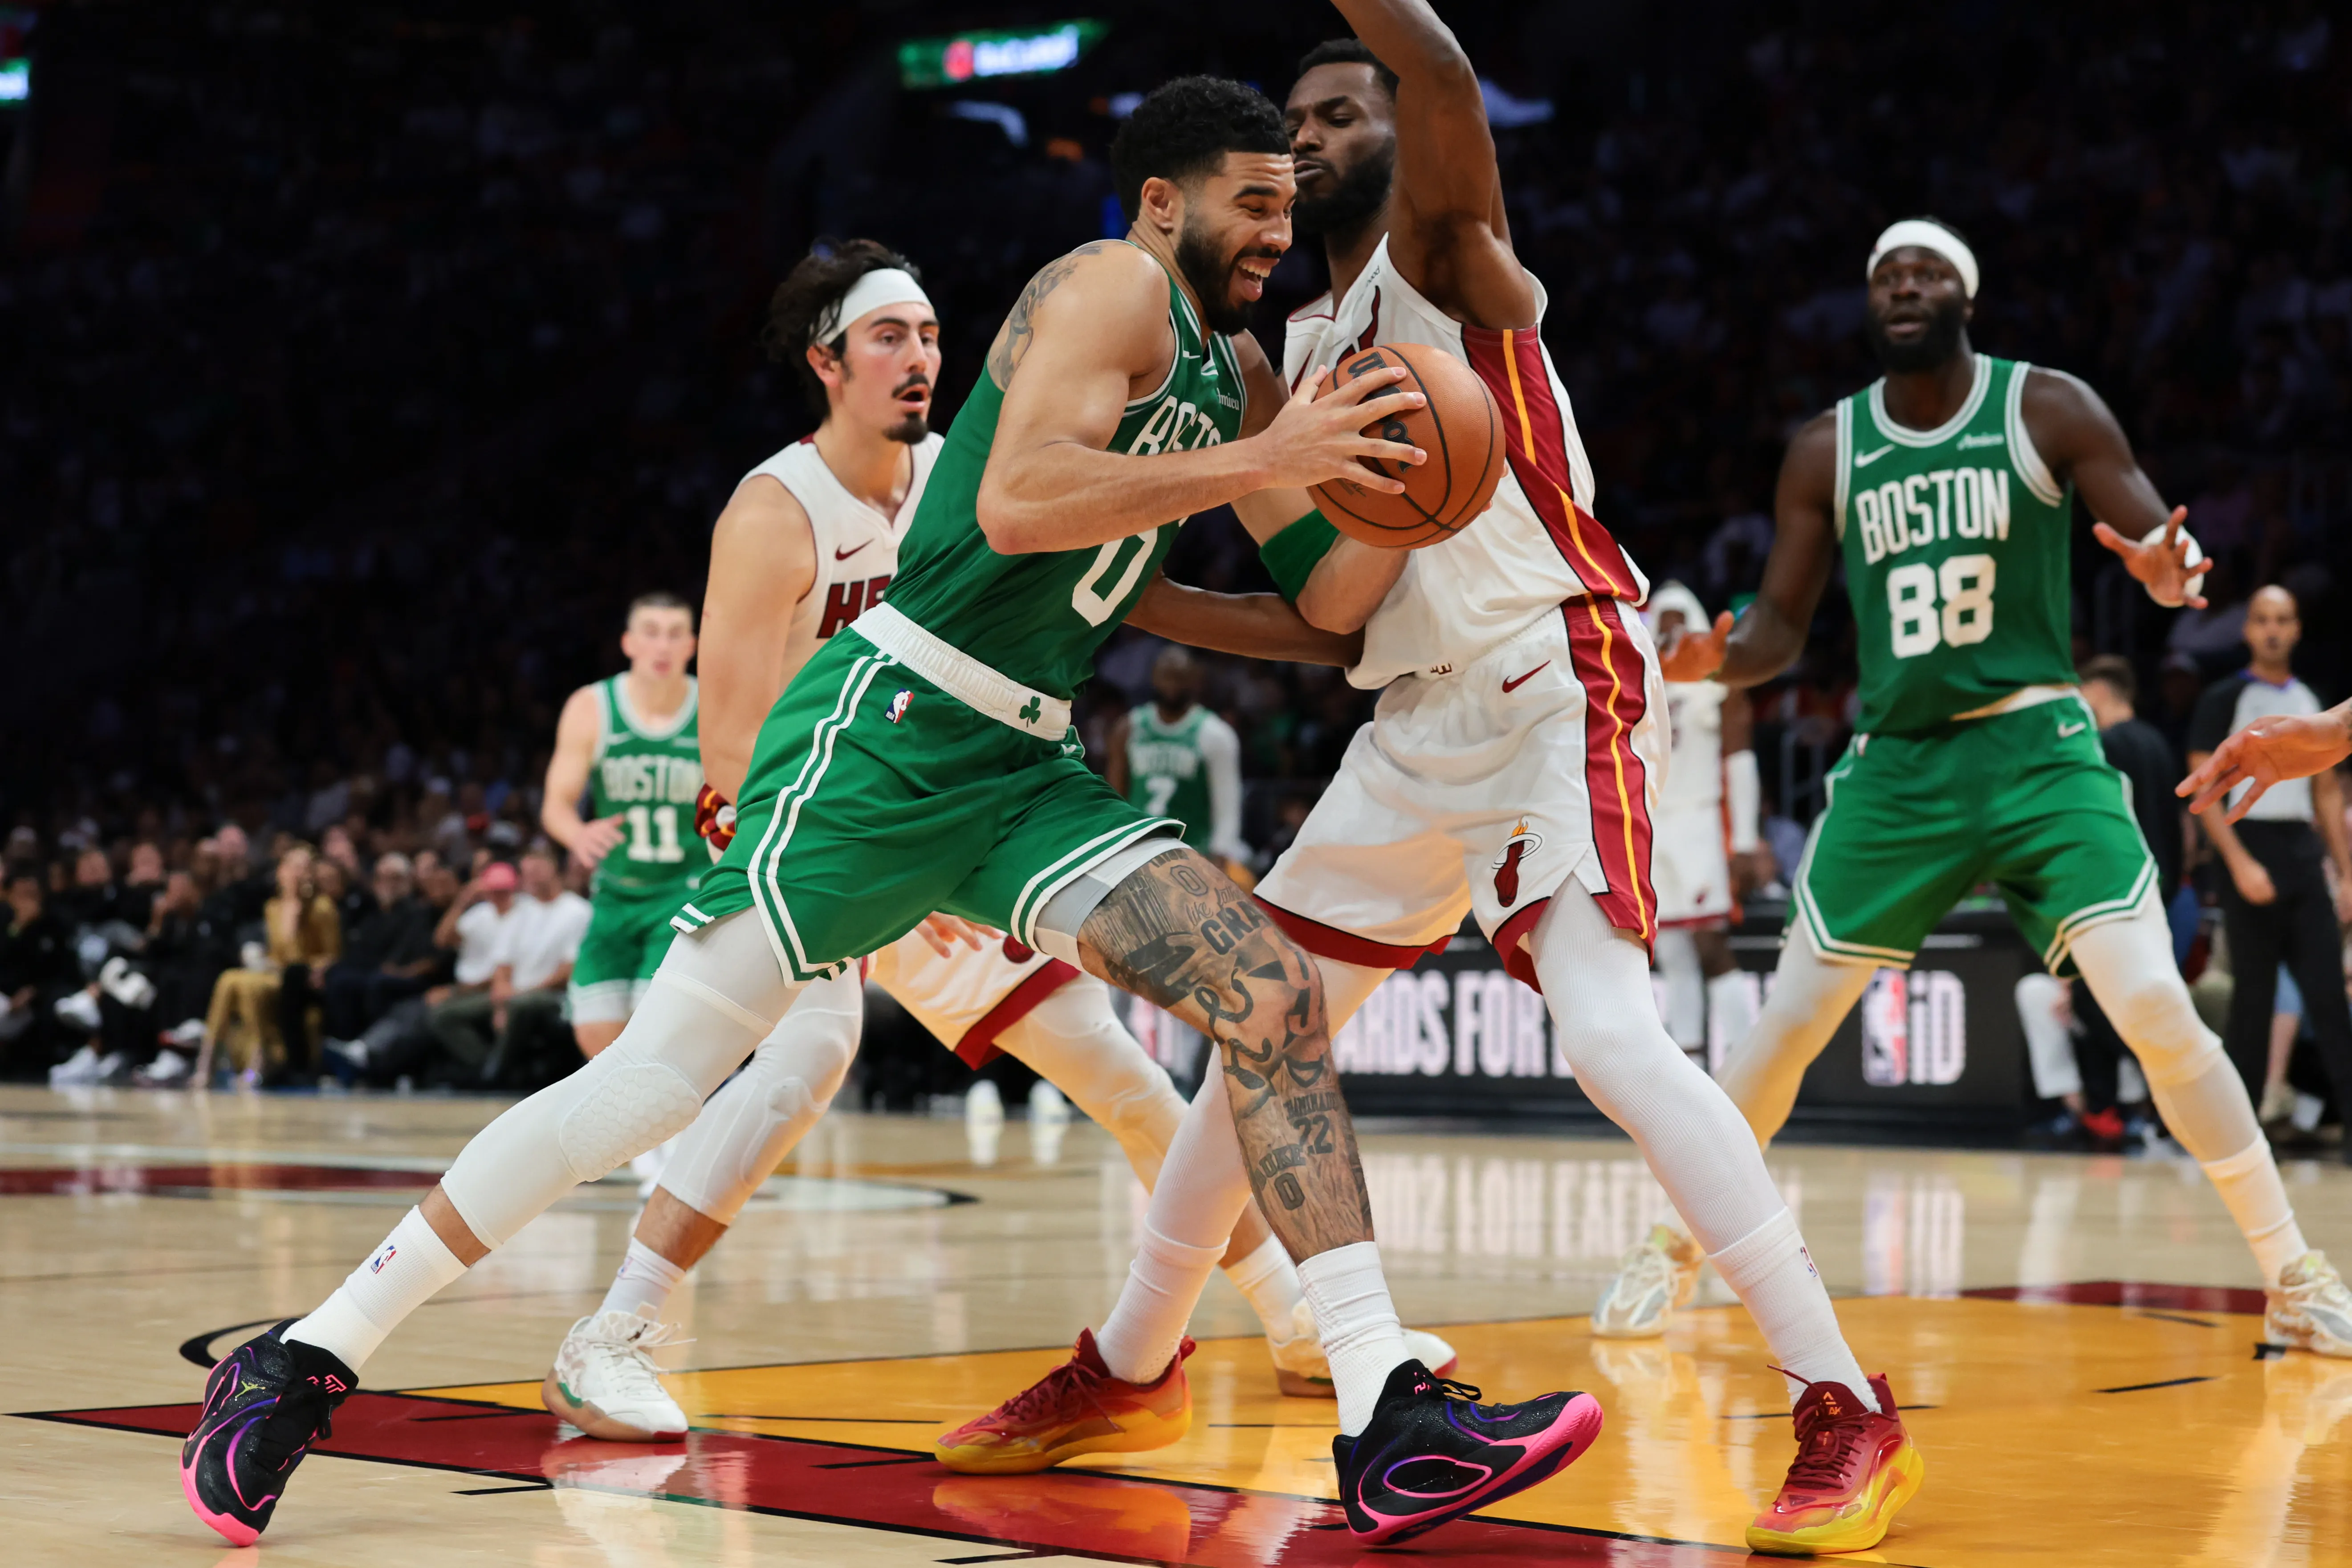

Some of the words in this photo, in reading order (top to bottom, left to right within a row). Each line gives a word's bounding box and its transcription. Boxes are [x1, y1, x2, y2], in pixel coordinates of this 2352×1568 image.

[1855, 466, 2011, 566] BOSTON
[815, 573, 891, 639] HE
[1886, 553, 1997, 659] 88
[885, 711, 895, 721] NBA
[627, 805, 685, 863] 11
[1332, 969, 1450, 1076] ARDS
[1453, 969, 1547, 1077] FOR
[1274, 1172, 1305, 1211] 0
